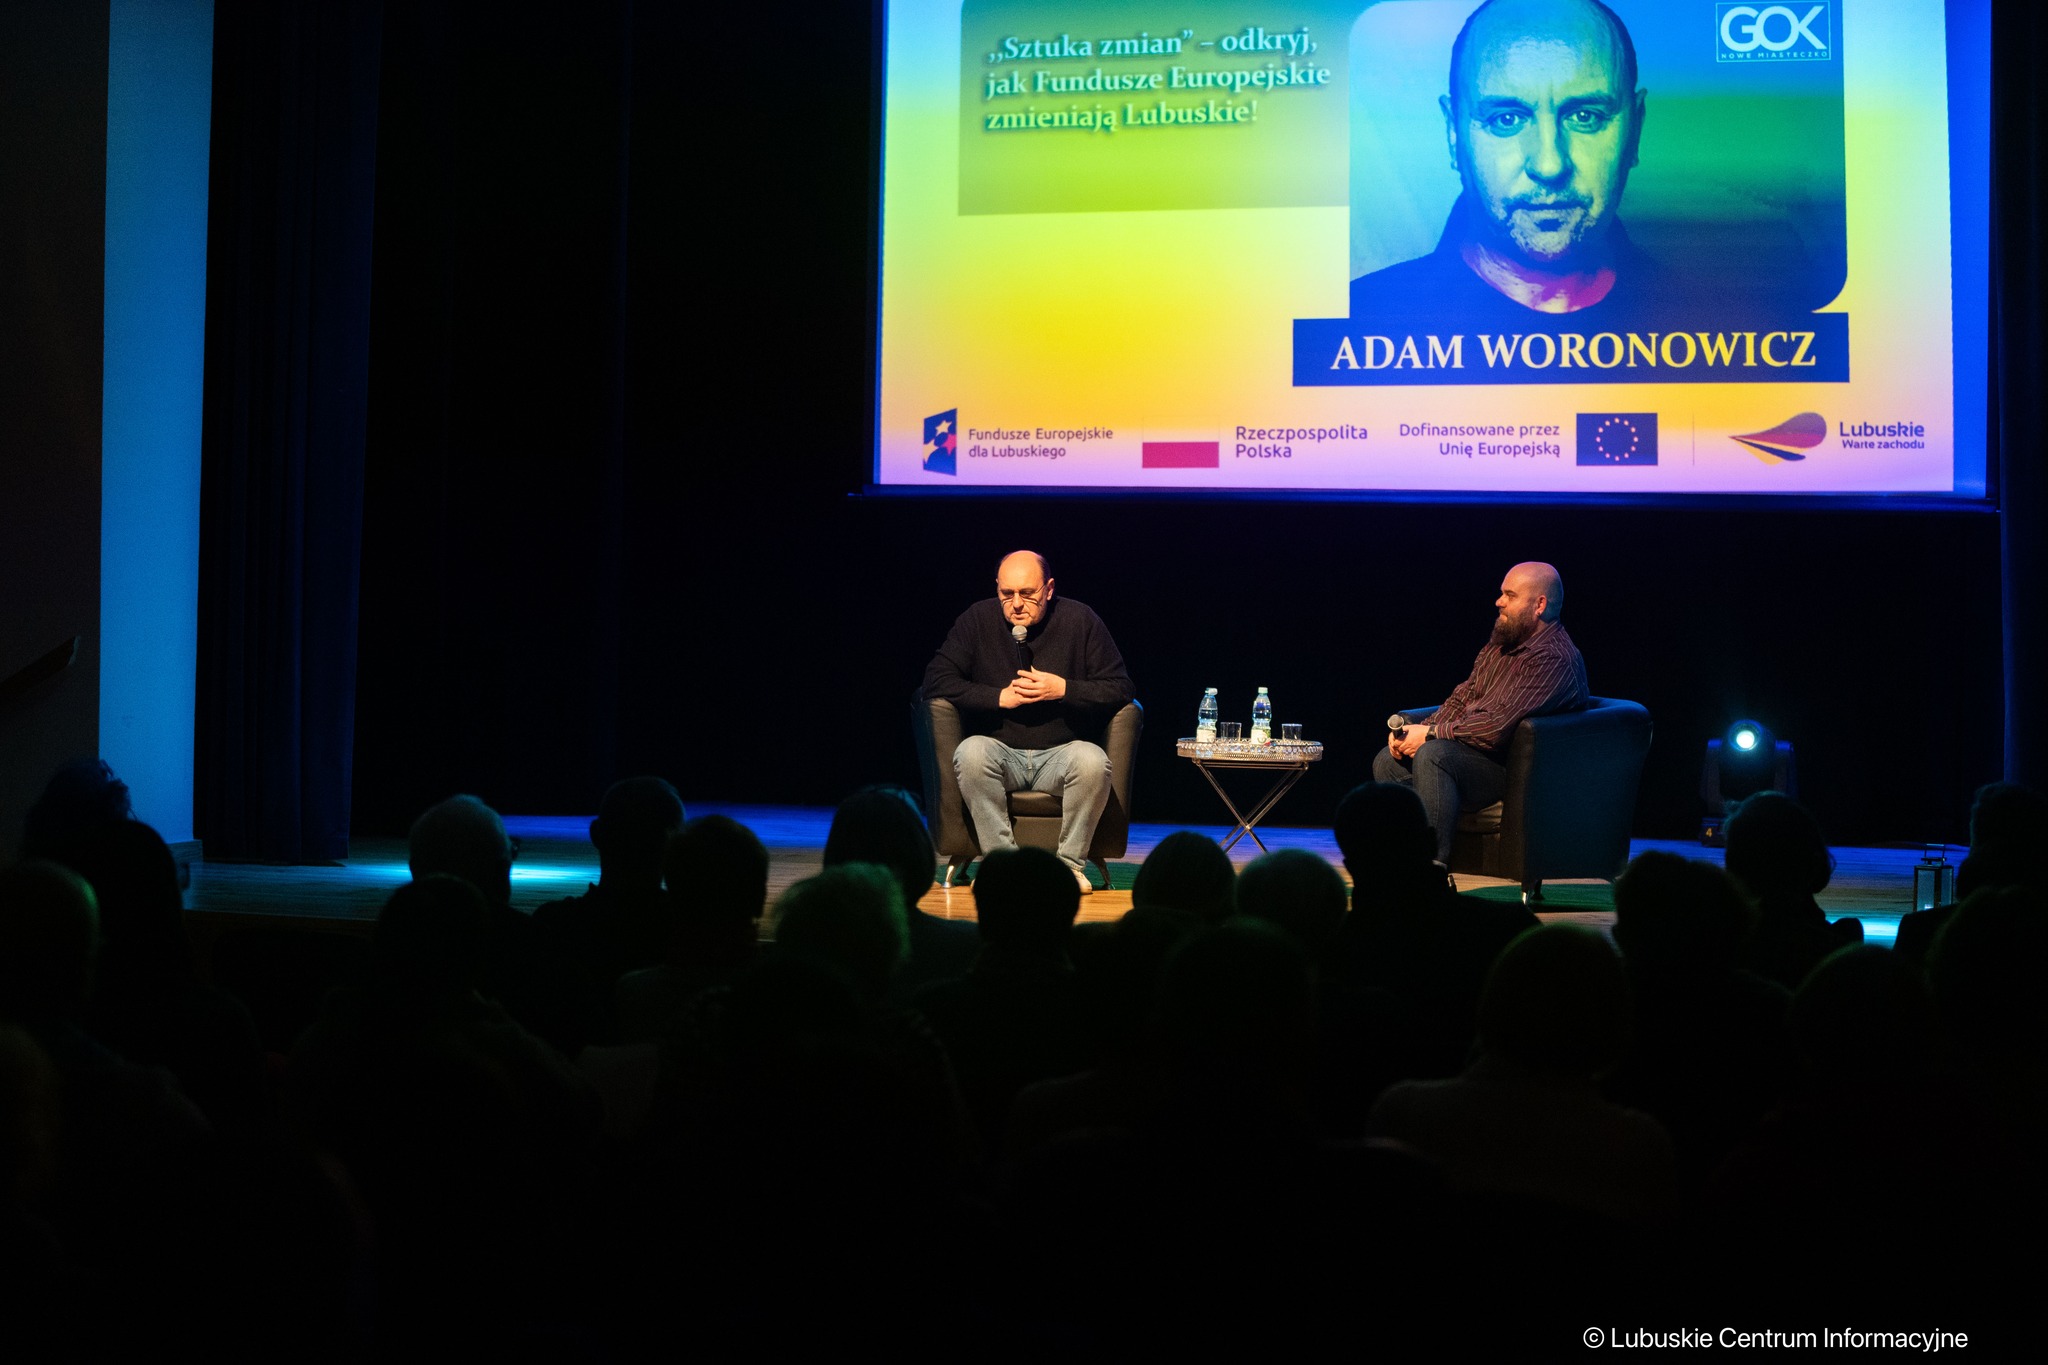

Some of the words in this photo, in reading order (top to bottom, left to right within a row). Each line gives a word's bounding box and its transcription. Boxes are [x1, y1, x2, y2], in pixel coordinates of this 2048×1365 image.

[1720, 5, 1828, 52] GOK
[1221, 26, 1318, 56] odkryj,
[987, 70, 1028, 100] jak
[1035, 67, 1163, 92] Fundusze
[1170, 61, 1331, 93] Europejskie
[987, 104, 1118, 133] zmieniają
[1125, 99, 1258, 125] Lubuskie!
[1330, 335, 1464, 370] ADAM
[1477, 331, 1817, 369] WORONOWICZ
[968, 428, 1031, 441] Fundusze
[1036, 427, 1114, 442] Europejskie
[1236, 424, 1368, 443] Rzeczpospolita
[1399, 423, 1515, 437] Dofinansowane
[1519, 425, 1560, 439] przez
[1840, 421, 1925, 437] Lubuskie
[968, 445, 988, 458] dla
[992, 444, 1066, 459] Lubuskiego
[1236, 444, 1292, 458] Polska
[1440, 442, 1473, 459] Unię
[1478, 441, 1561, 458] Europejską
[1842, 439, 1875, 449] Warte
[1877, 439, 1925, 449] zachodu
[1705, 827, 1713, 837] 4
